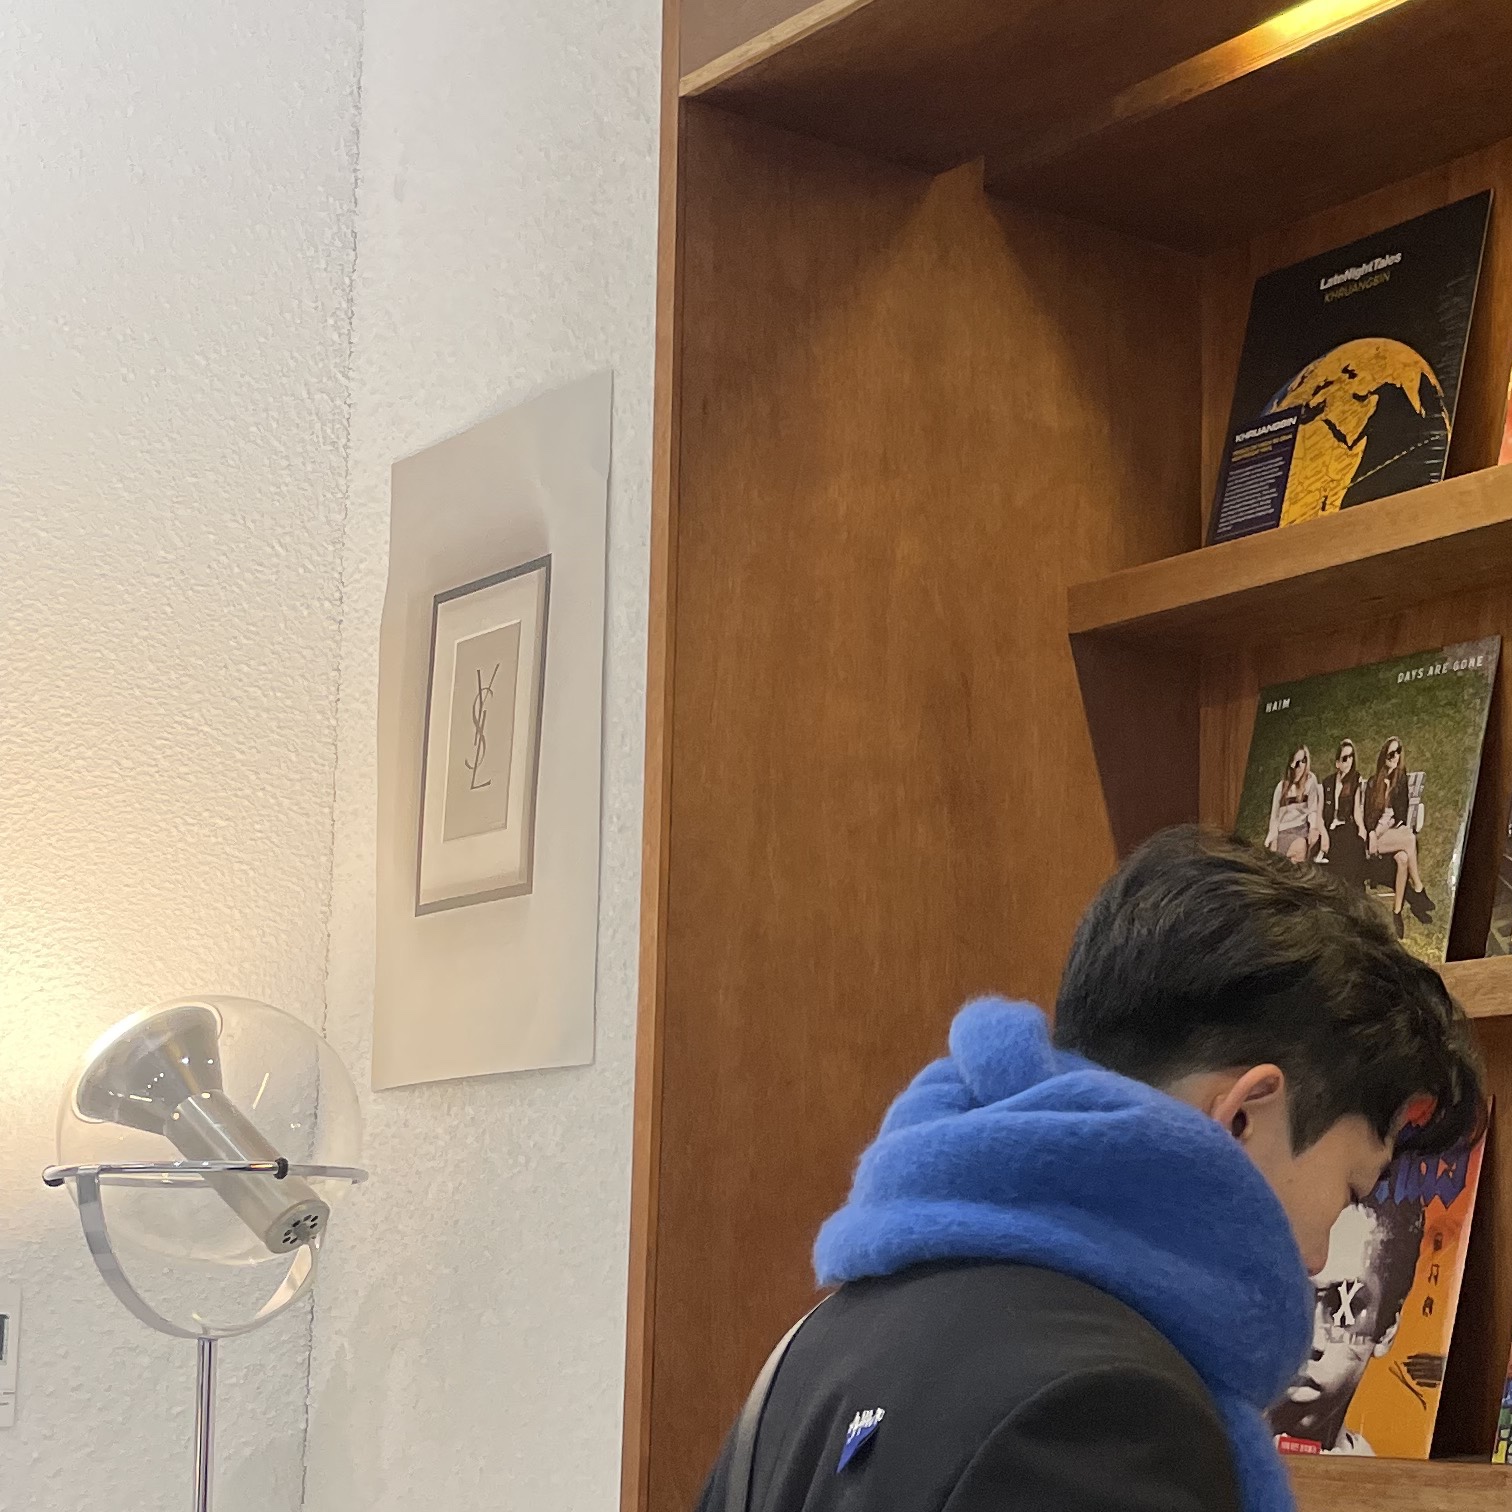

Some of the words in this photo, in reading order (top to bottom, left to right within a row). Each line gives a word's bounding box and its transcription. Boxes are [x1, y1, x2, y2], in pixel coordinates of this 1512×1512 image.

[1397, 667, 1424, 684] DAYS
[1426, 661, 1449, 677] ARE
[1452, 655, 1484, 672] GONE
[1265, 698, 1291, 713] HAIM
